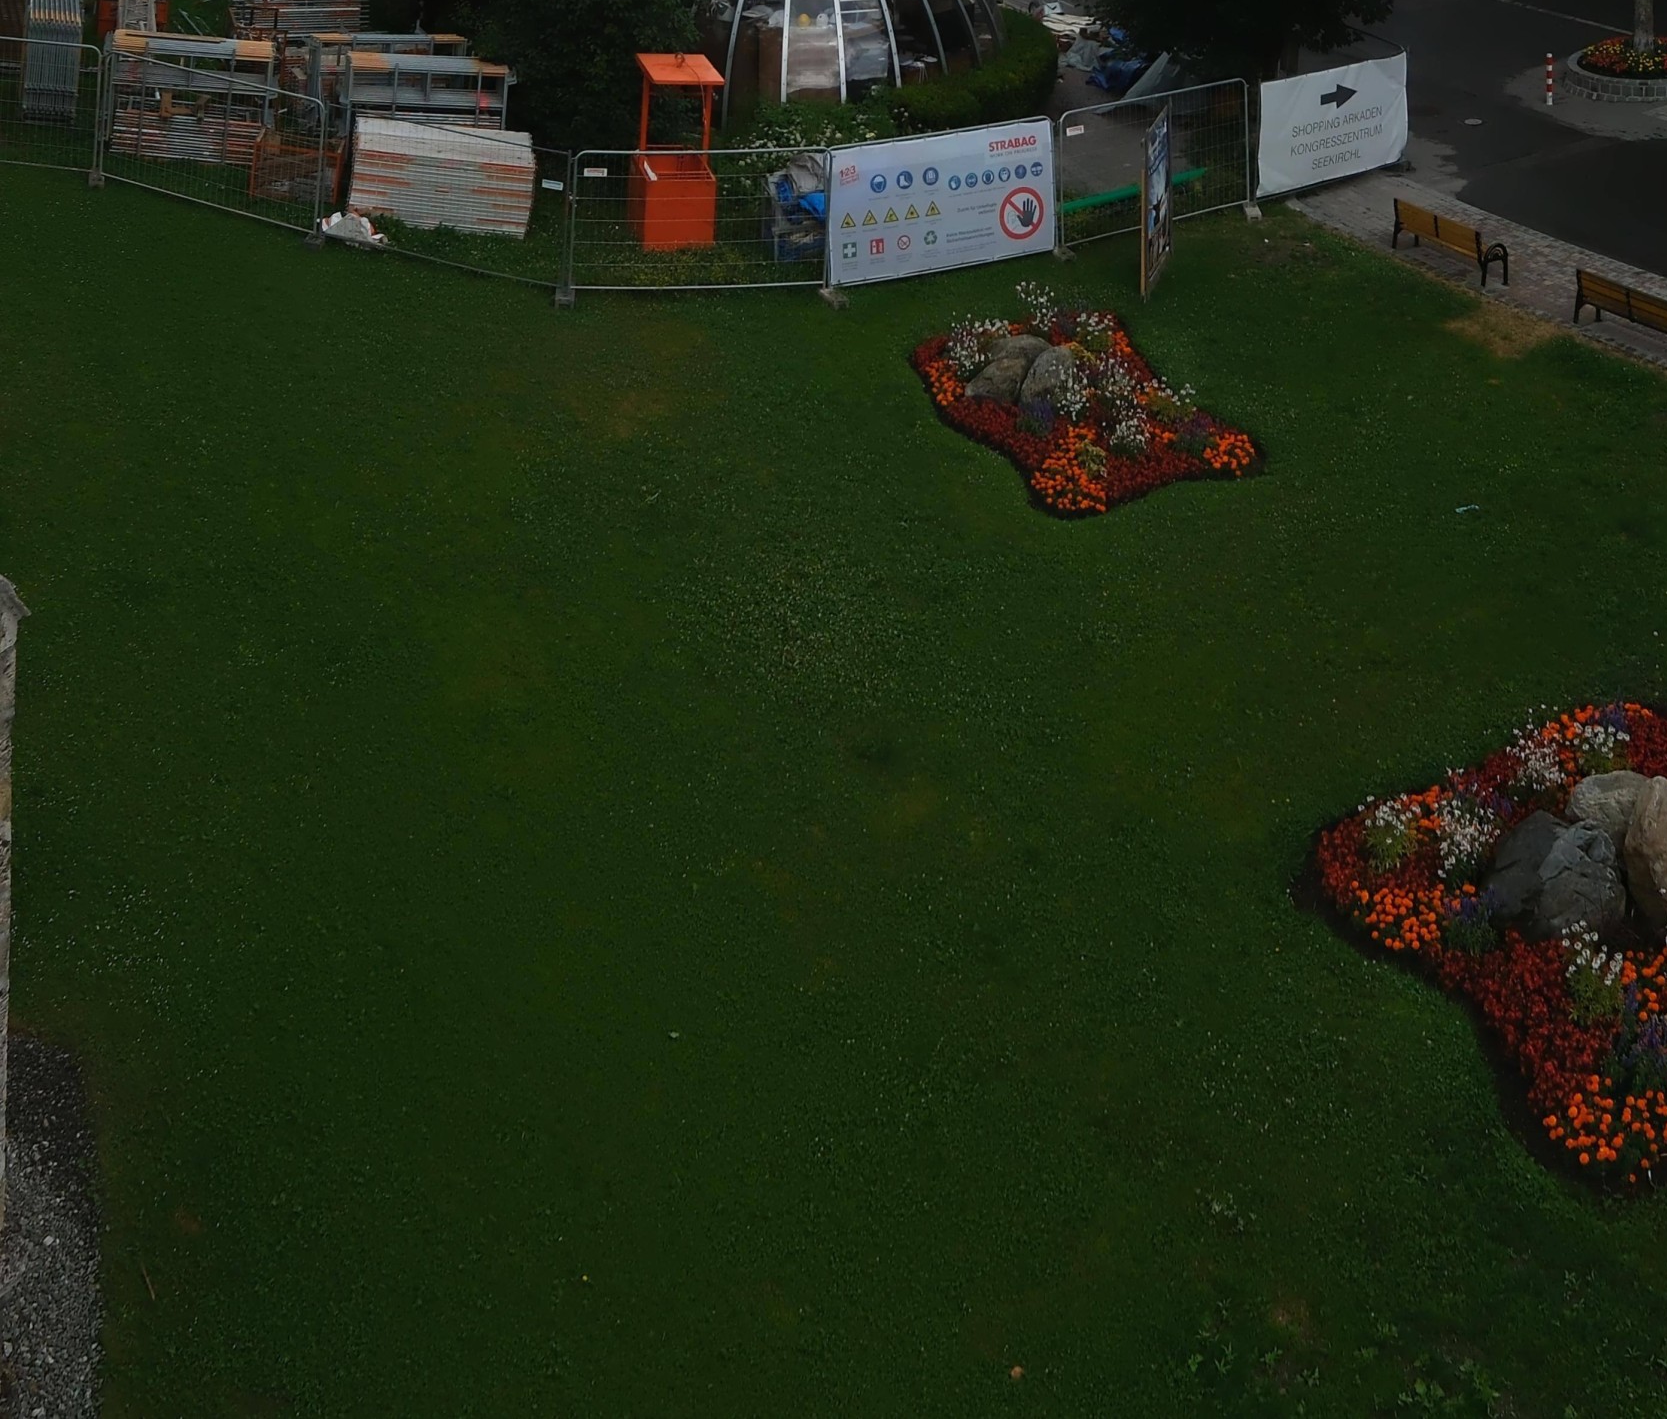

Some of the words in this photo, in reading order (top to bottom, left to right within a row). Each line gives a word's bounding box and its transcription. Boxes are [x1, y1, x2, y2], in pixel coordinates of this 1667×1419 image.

[1292, 116, 1340, 139] SHOPPING
[1342, 105, 1382, 126] ARKADEN
[988, 135, 1037, 152] STRABAG
[1290, 123, 1383, 157] KONGRESSZENTRUM
[1311, 150, 1361, 170] SEEKIRCHL
